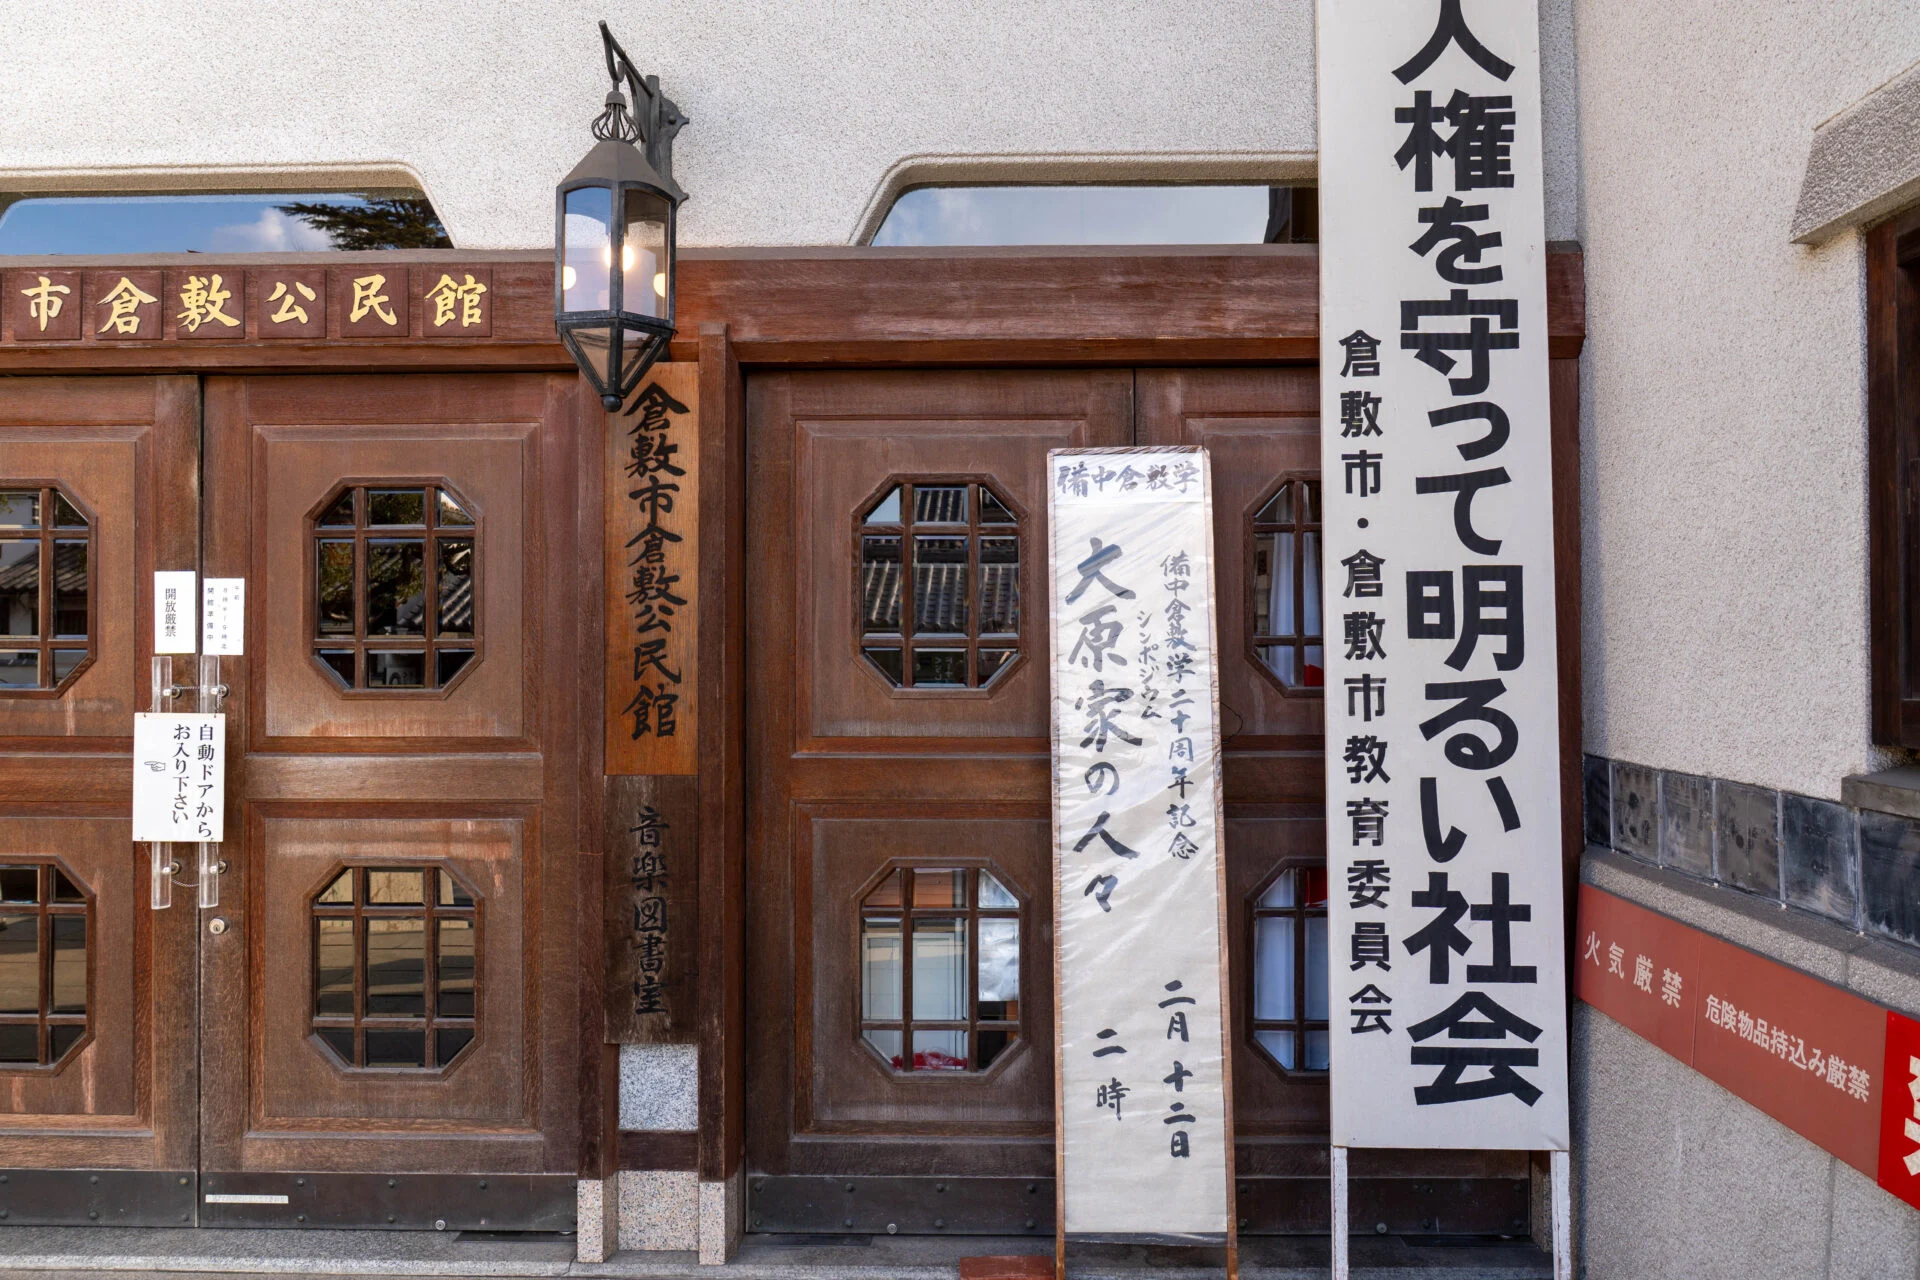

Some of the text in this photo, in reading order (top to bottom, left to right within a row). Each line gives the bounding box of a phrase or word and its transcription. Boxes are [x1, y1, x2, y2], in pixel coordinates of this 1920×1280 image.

[20, 273, 488, 335] 市倉敷公民館
[1057, 460, 1200, 497] 備中倉敷学
[621, 381, 691, 741] 倉敷市倉敷公民館
[1391, 0, 1543, 1107] 人権を守って明るい社会
[165, 588, 177, 637] 開放厳禁
[1136, 609, 1163, 720] シンポジウム
[1065, 537, 1143, 913] 大原家の人々
[1159, 553, 1199, 861] 備中倉敷学二十周年記念
[1339, 329, 1393, 1035] 倉敷市・倉敷市教育委員会
[172, 723, 191, 825] お入り下さい
[196, 724, 215, 839] 自動ドアから
[1584, 931, 1682, 1008] 火気厳禁
[1705, 994, 1871, 1103] 危険物品持込み厳禁
